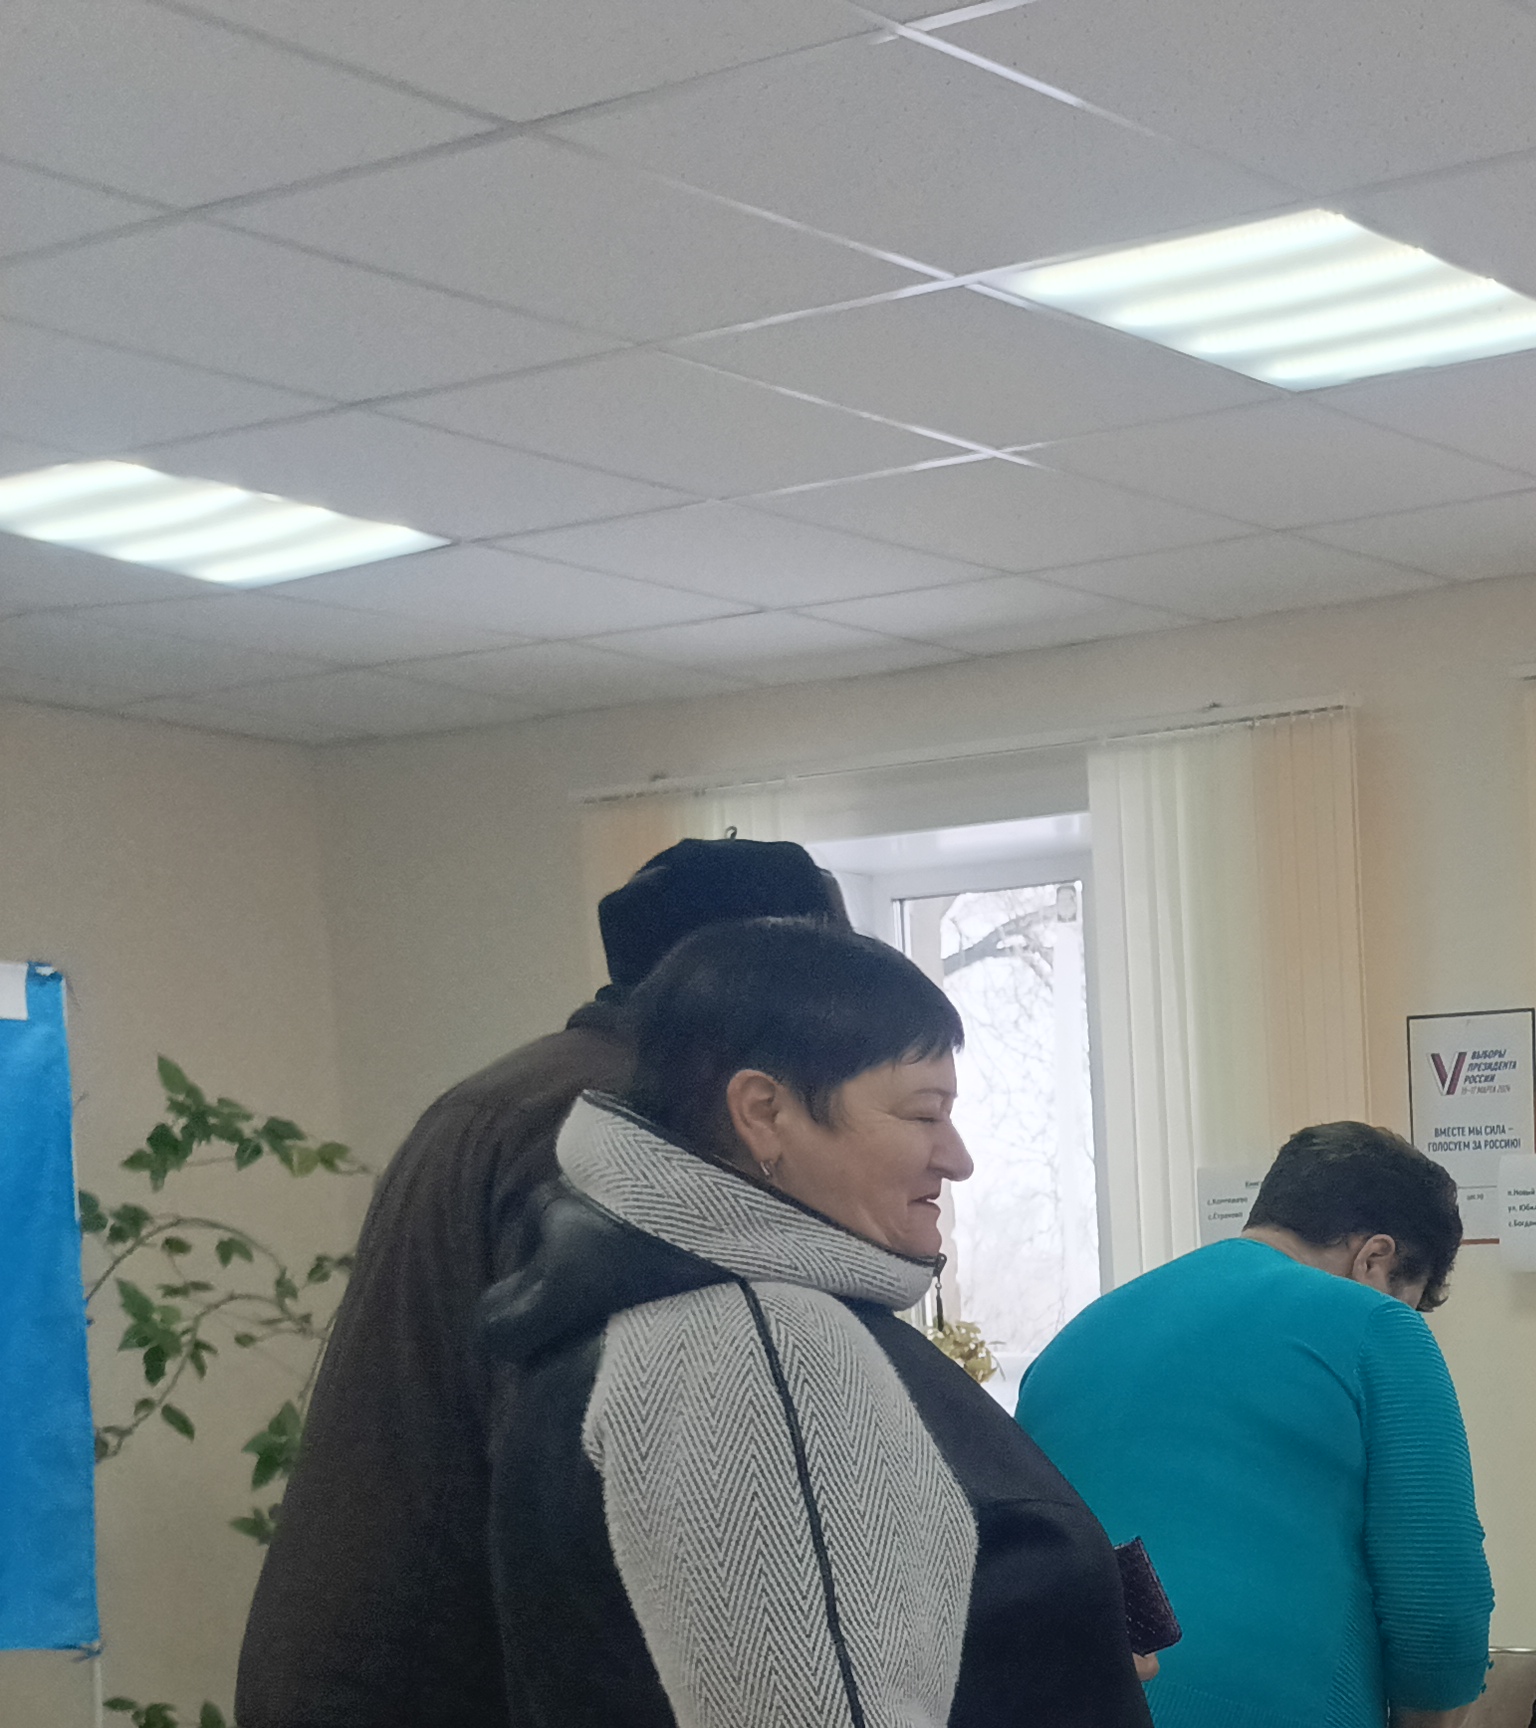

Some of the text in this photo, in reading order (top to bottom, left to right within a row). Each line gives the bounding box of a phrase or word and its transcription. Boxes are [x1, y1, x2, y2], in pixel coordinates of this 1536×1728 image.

[1471, 1049, 1507, 1060] ВЫБОРЫ
[1467, 1061, 1517, 1072] ПРЕЗИДЕНТА
[1463, 1074, 1496, 1084] РОССИИ
[1434, 1127, 1466, 1138] ВМЕСТЕ
[1468, 1126, 1482, 1137] МЫ
[1484, 1124, 1506, 1136] СИЛА
[1428, 1138, 1521, 1152] ГОЛОСУЕМ ЗА РОССИЮ!
